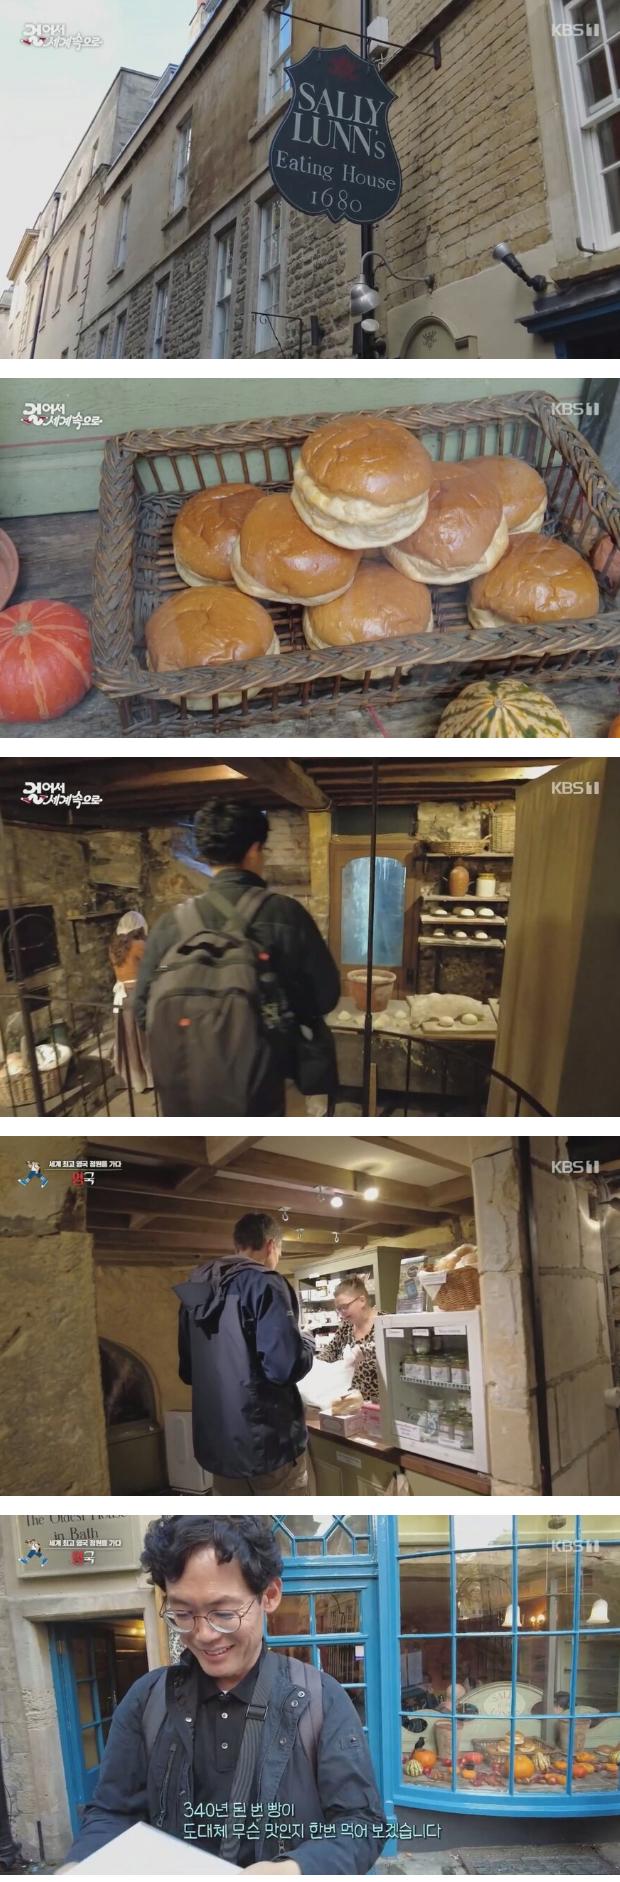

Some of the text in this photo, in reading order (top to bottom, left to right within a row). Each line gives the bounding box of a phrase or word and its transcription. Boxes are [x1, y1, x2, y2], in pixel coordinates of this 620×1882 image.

[298, 82, 385, 127] SALLY
[276, 150, 397, 192] Eating House
[311, 187, 362, 213] 1680
